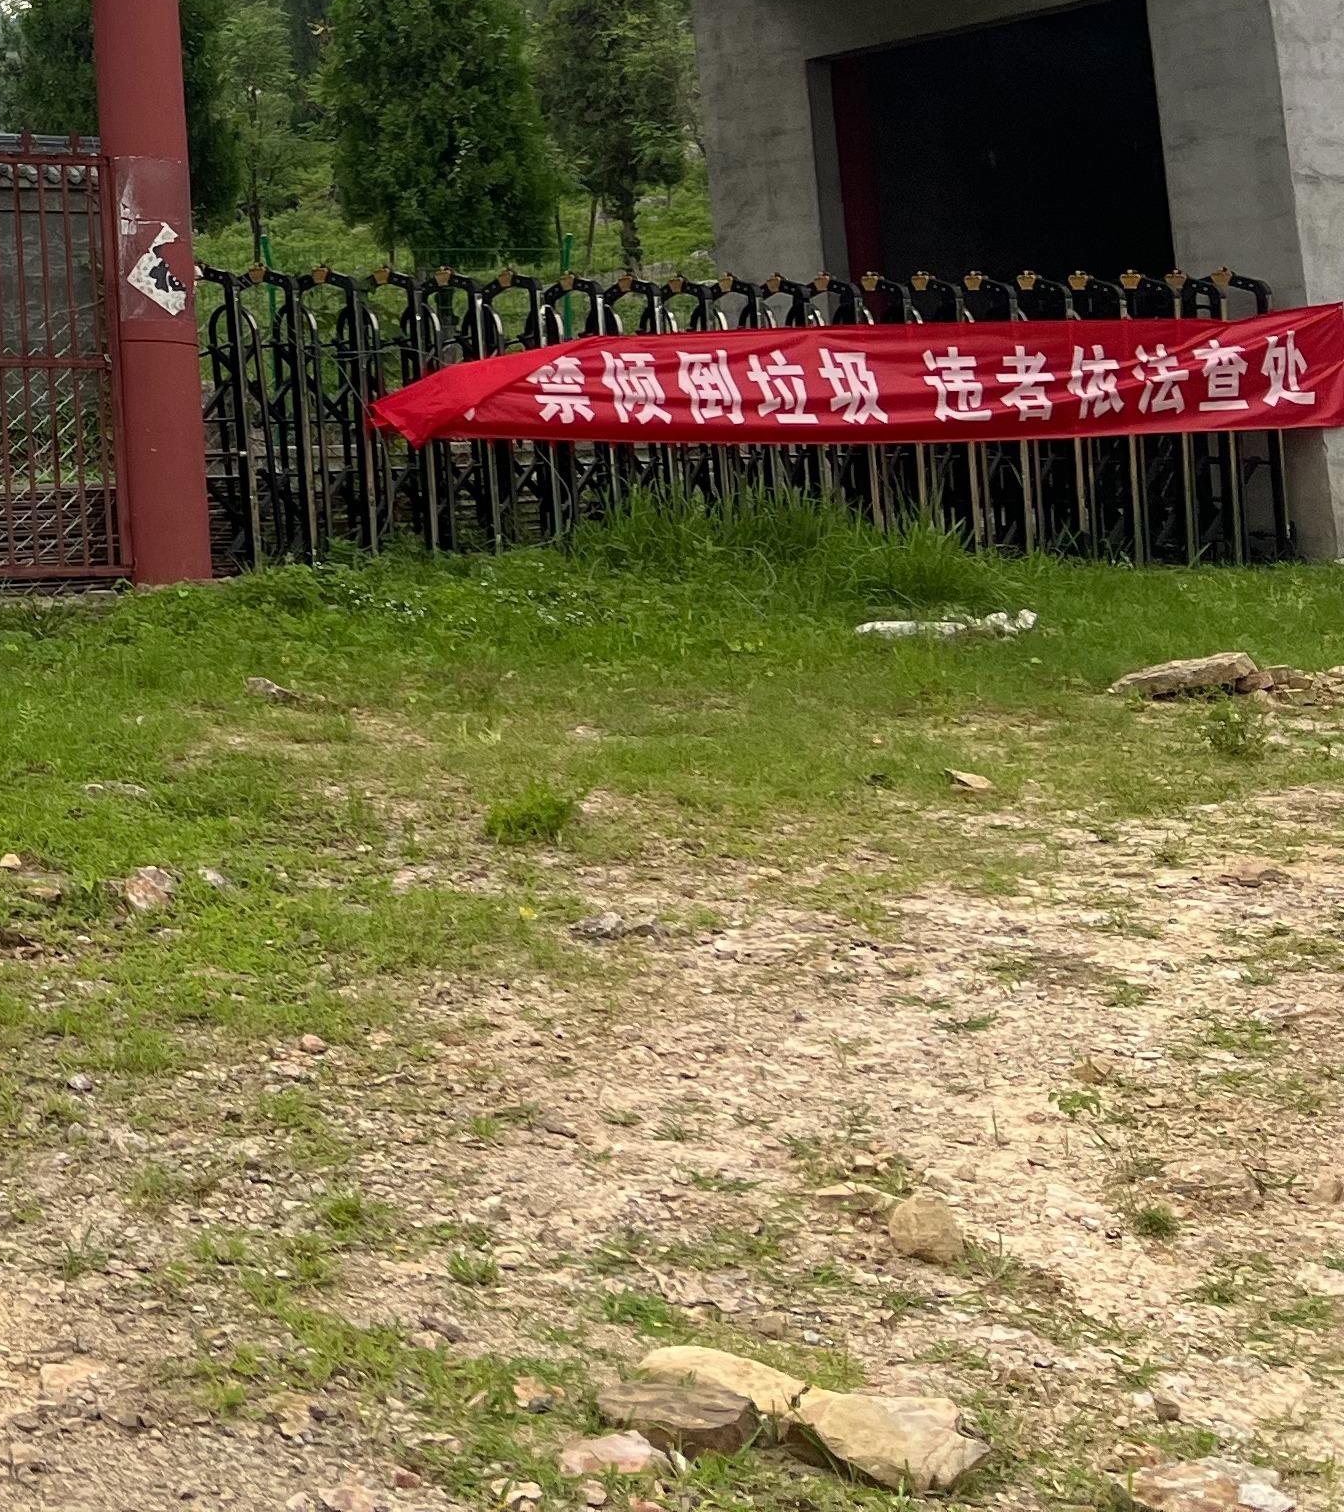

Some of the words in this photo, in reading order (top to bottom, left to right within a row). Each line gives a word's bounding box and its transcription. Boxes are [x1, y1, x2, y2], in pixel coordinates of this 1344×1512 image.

[463, 347, 889, 425] 禁倾倒垃圾
[922, 330, 1316, 423] 违者依法查处
